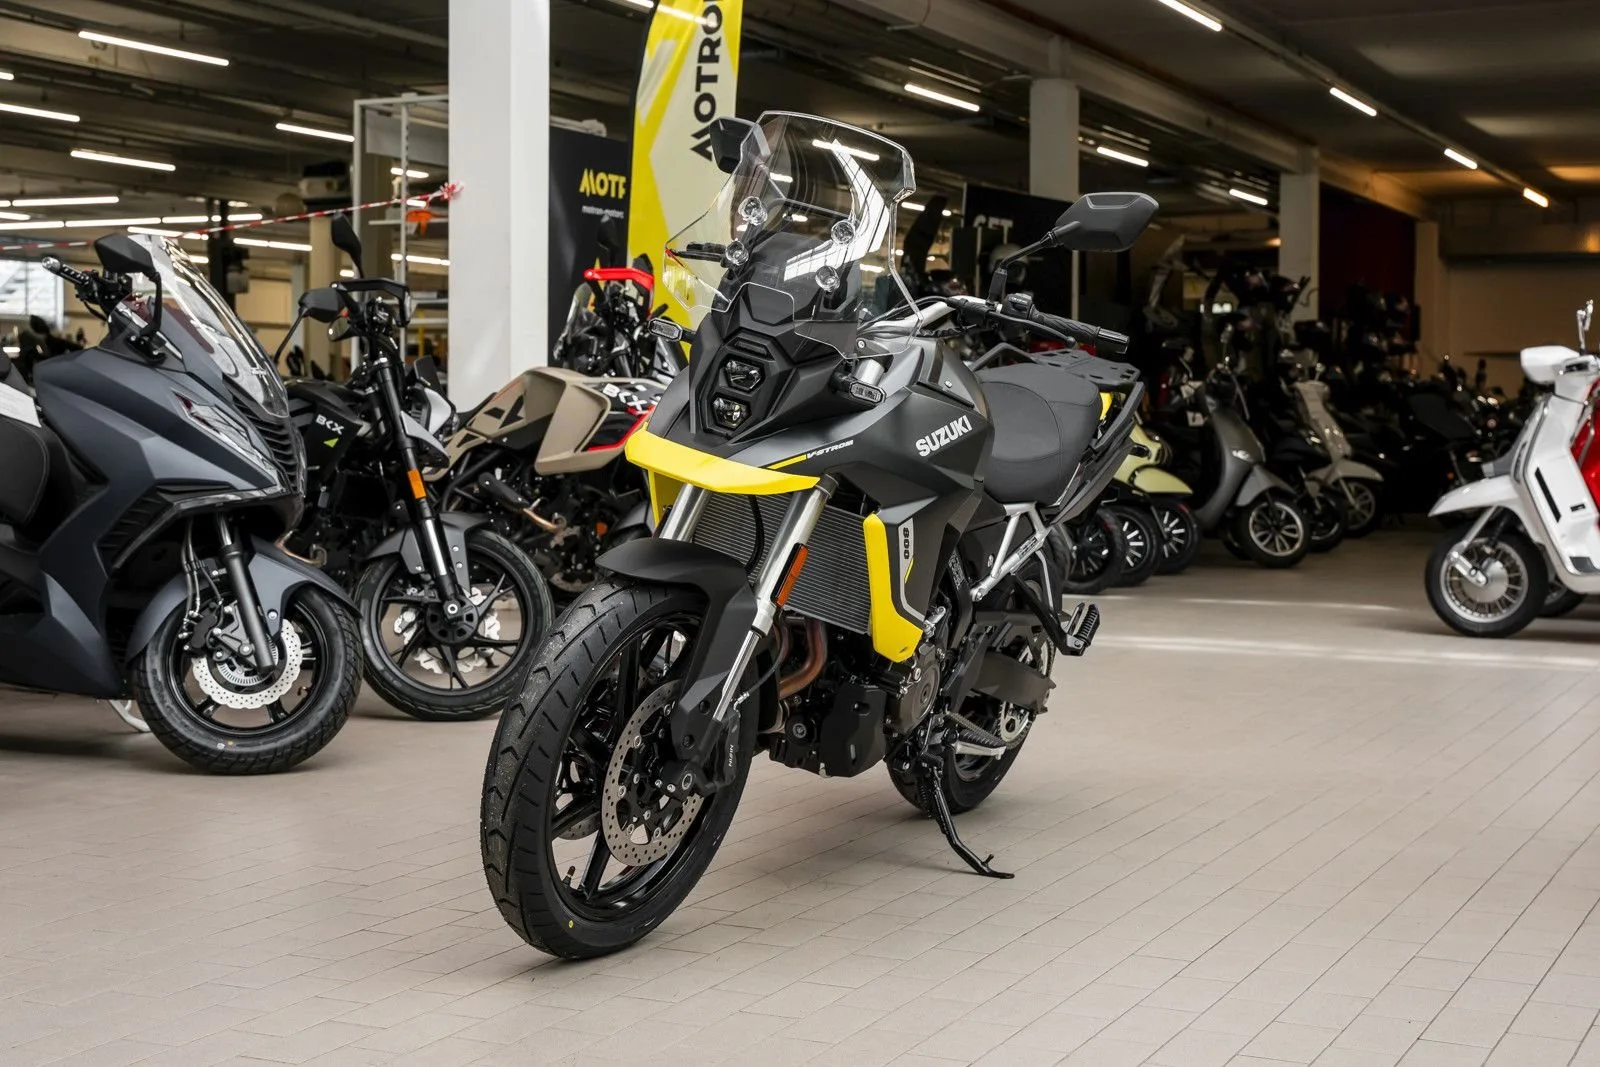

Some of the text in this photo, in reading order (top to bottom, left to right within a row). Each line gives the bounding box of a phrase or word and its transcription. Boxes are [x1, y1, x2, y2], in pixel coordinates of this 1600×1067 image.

[690, 0, 723, 162] MOTRO
[602, 383, 648, 411] BCX
[316, 414, 344, 435] BCX
[915, 414, 973, 457] SUZUKI
